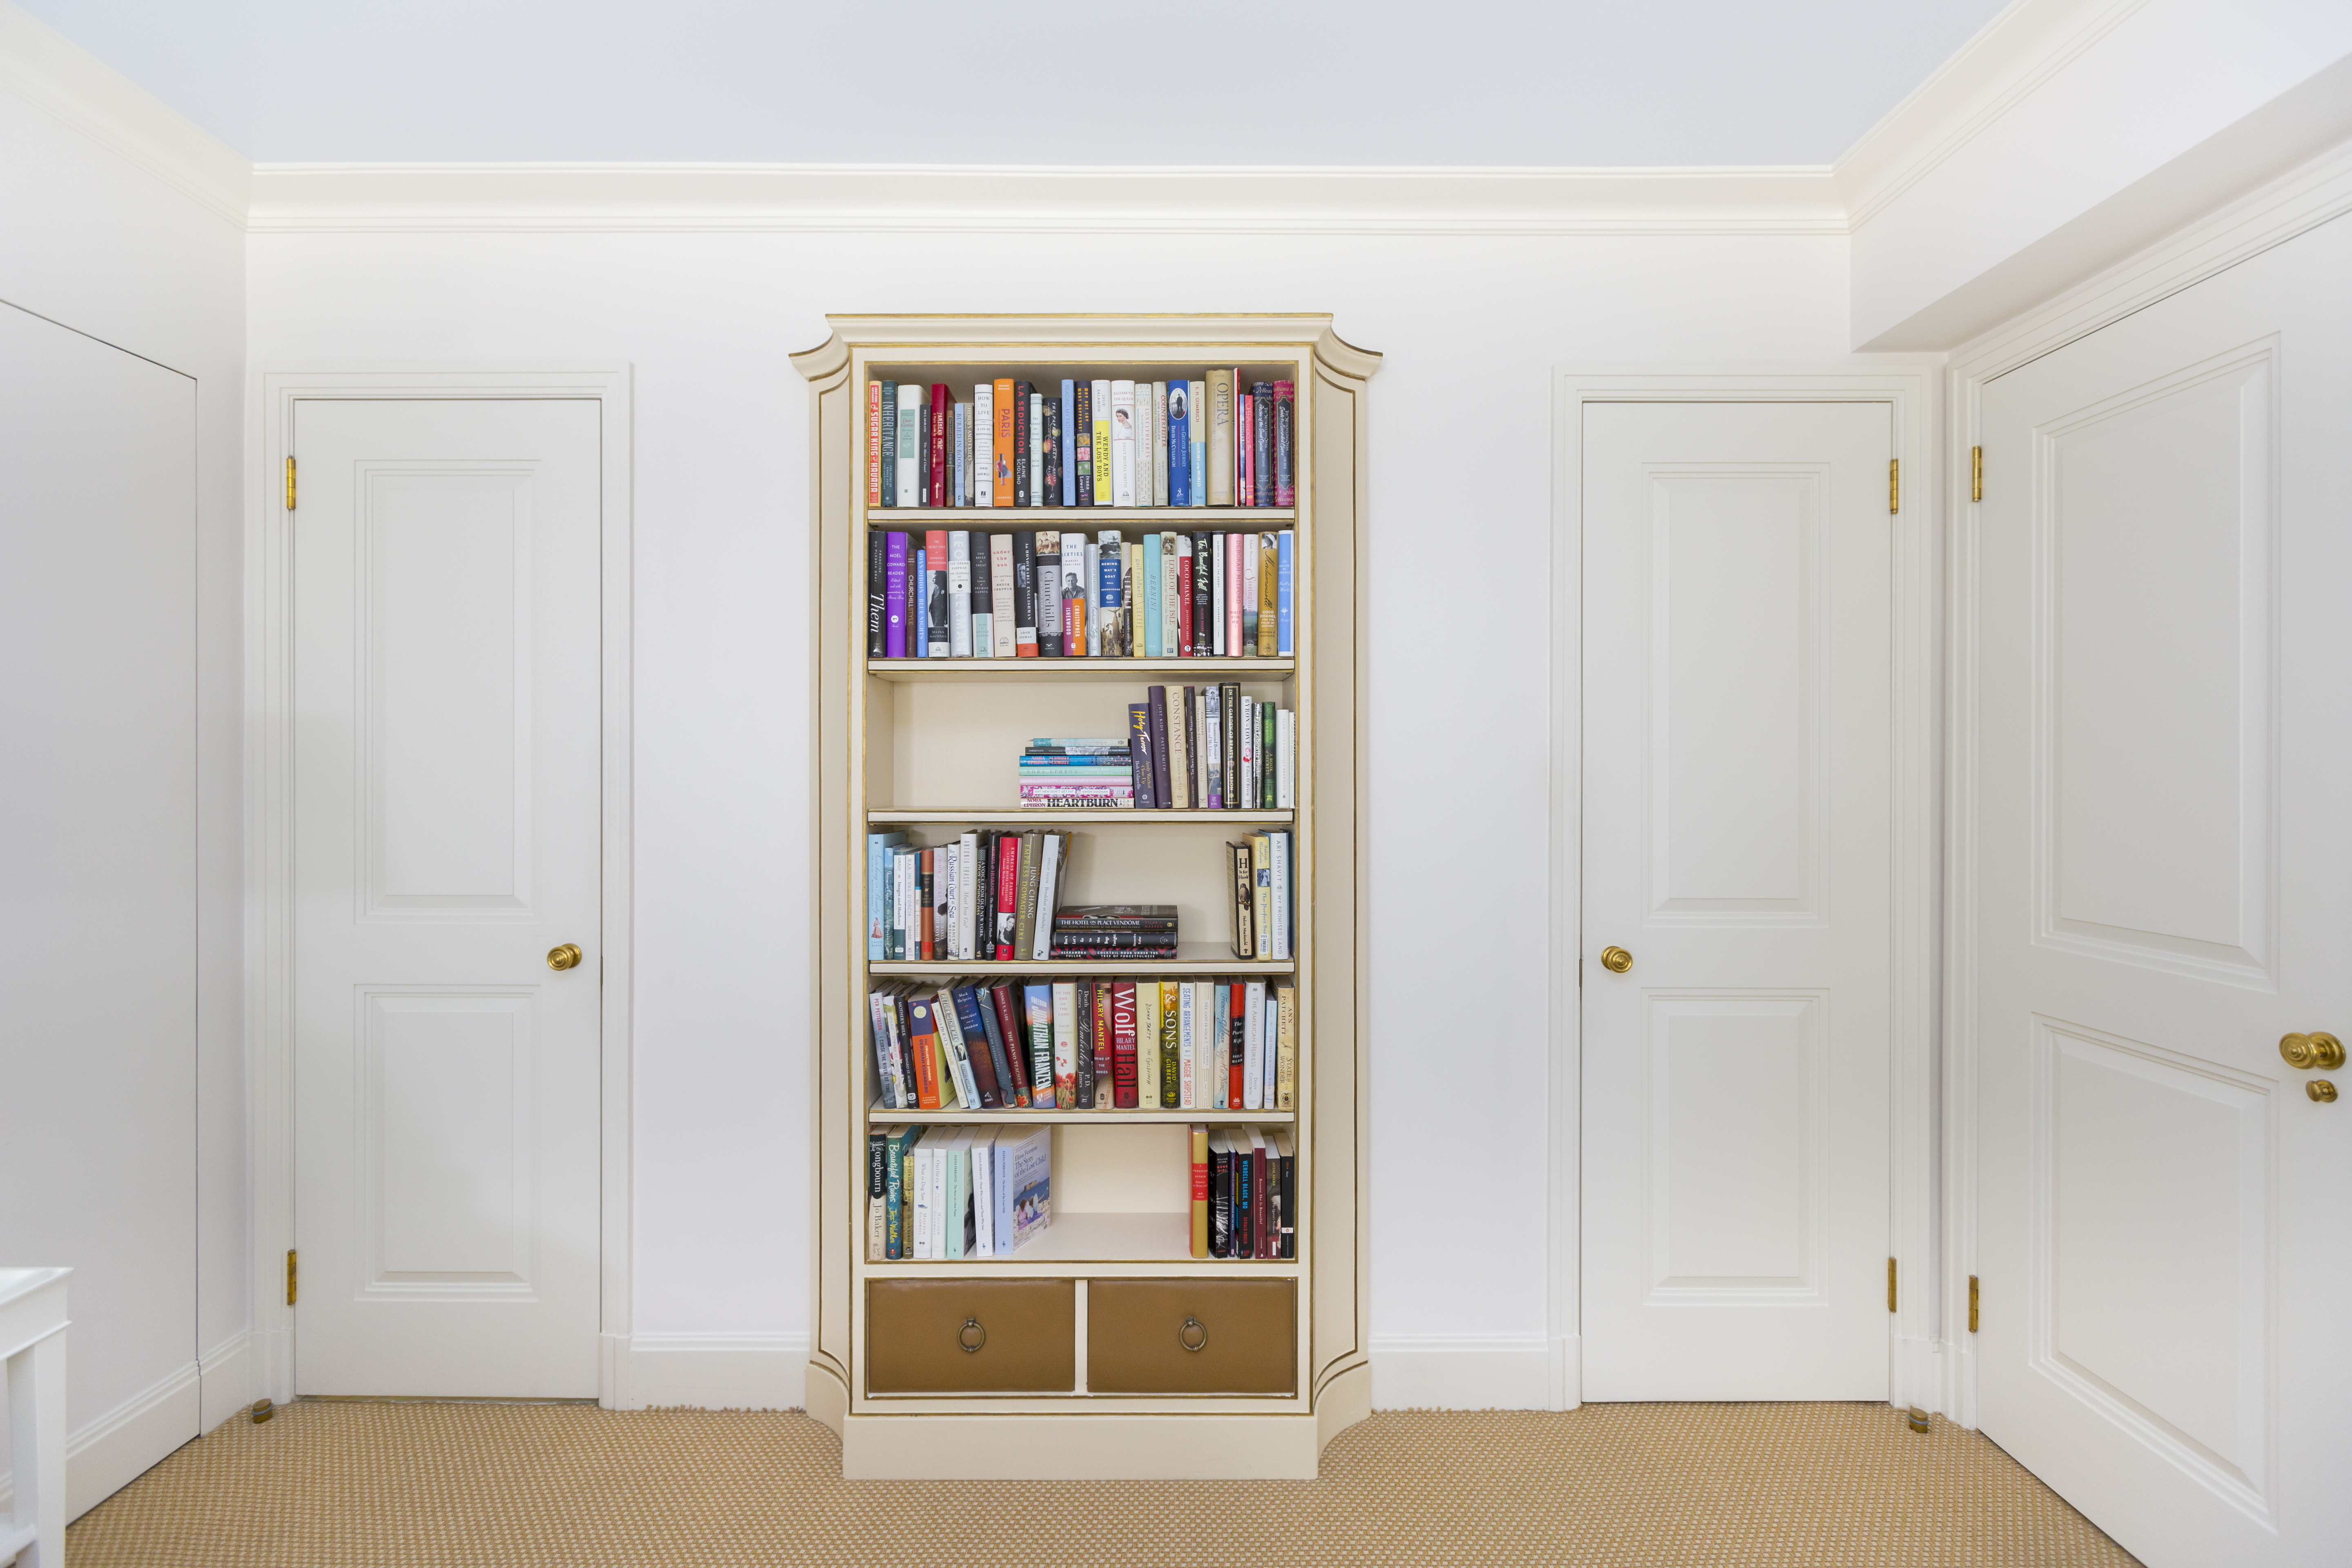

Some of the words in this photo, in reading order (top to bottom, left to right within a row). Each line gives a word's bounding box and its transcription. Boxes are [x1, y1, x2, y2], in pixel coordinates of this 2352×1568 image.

[1018, 386, 1024, 397] LA
[1217, 383, 1229, 425] OPERA
[882, 401, 893, 457] INHERITANCE
[1002, 409, 1010, 437] PARIS
[1198, 539, 1207, 550] The
[1196, 552, 1208, 575] Beautiful
[1169, 582, 1175, 591] OF
[1197, 577, 1208, 591] Fall
[1264, 551, 1274, 608] Mademoiselle
[1044, 571, 1054, 627] Churchills
[871, 593, 884, 633] Them
[1131, 711, 1146, 733] Holy
[1172, 693, 1182, 754] CONSTANCE
[1137, 733, 1150, 755] Terror
[1047, 799, 1118, 807] HEARTBURN
[948, 855, 957, 882] Russian
[948, 883, 956, 900] Court
[948, 905, 956, 918] Sea
[1115, 988, 1135, 1036] Wolf
[1166, 993, 1176, 1004] &
[1032, 1006, 1049, 1048] JONATHAN
[1166, 1010, 1176, 1049] SONS
[1078, 1016, 1091, 1067] Pemberley
[1013, 1061, 1022, 1085] TEACHER
[1035, 1052, 1051, 1091] FRANZEN
[1116, 1052, 1136, 1088] Hall
[1183, 1059, 1192, 1078] MAGGIE
[870, 1141, 886, 1192] Longbourn
[888, 1143, 900, 1178] Beautiful
[889, 1180, 900, 1203] Ruins
[873, 1203, 882, 1213] Jo
